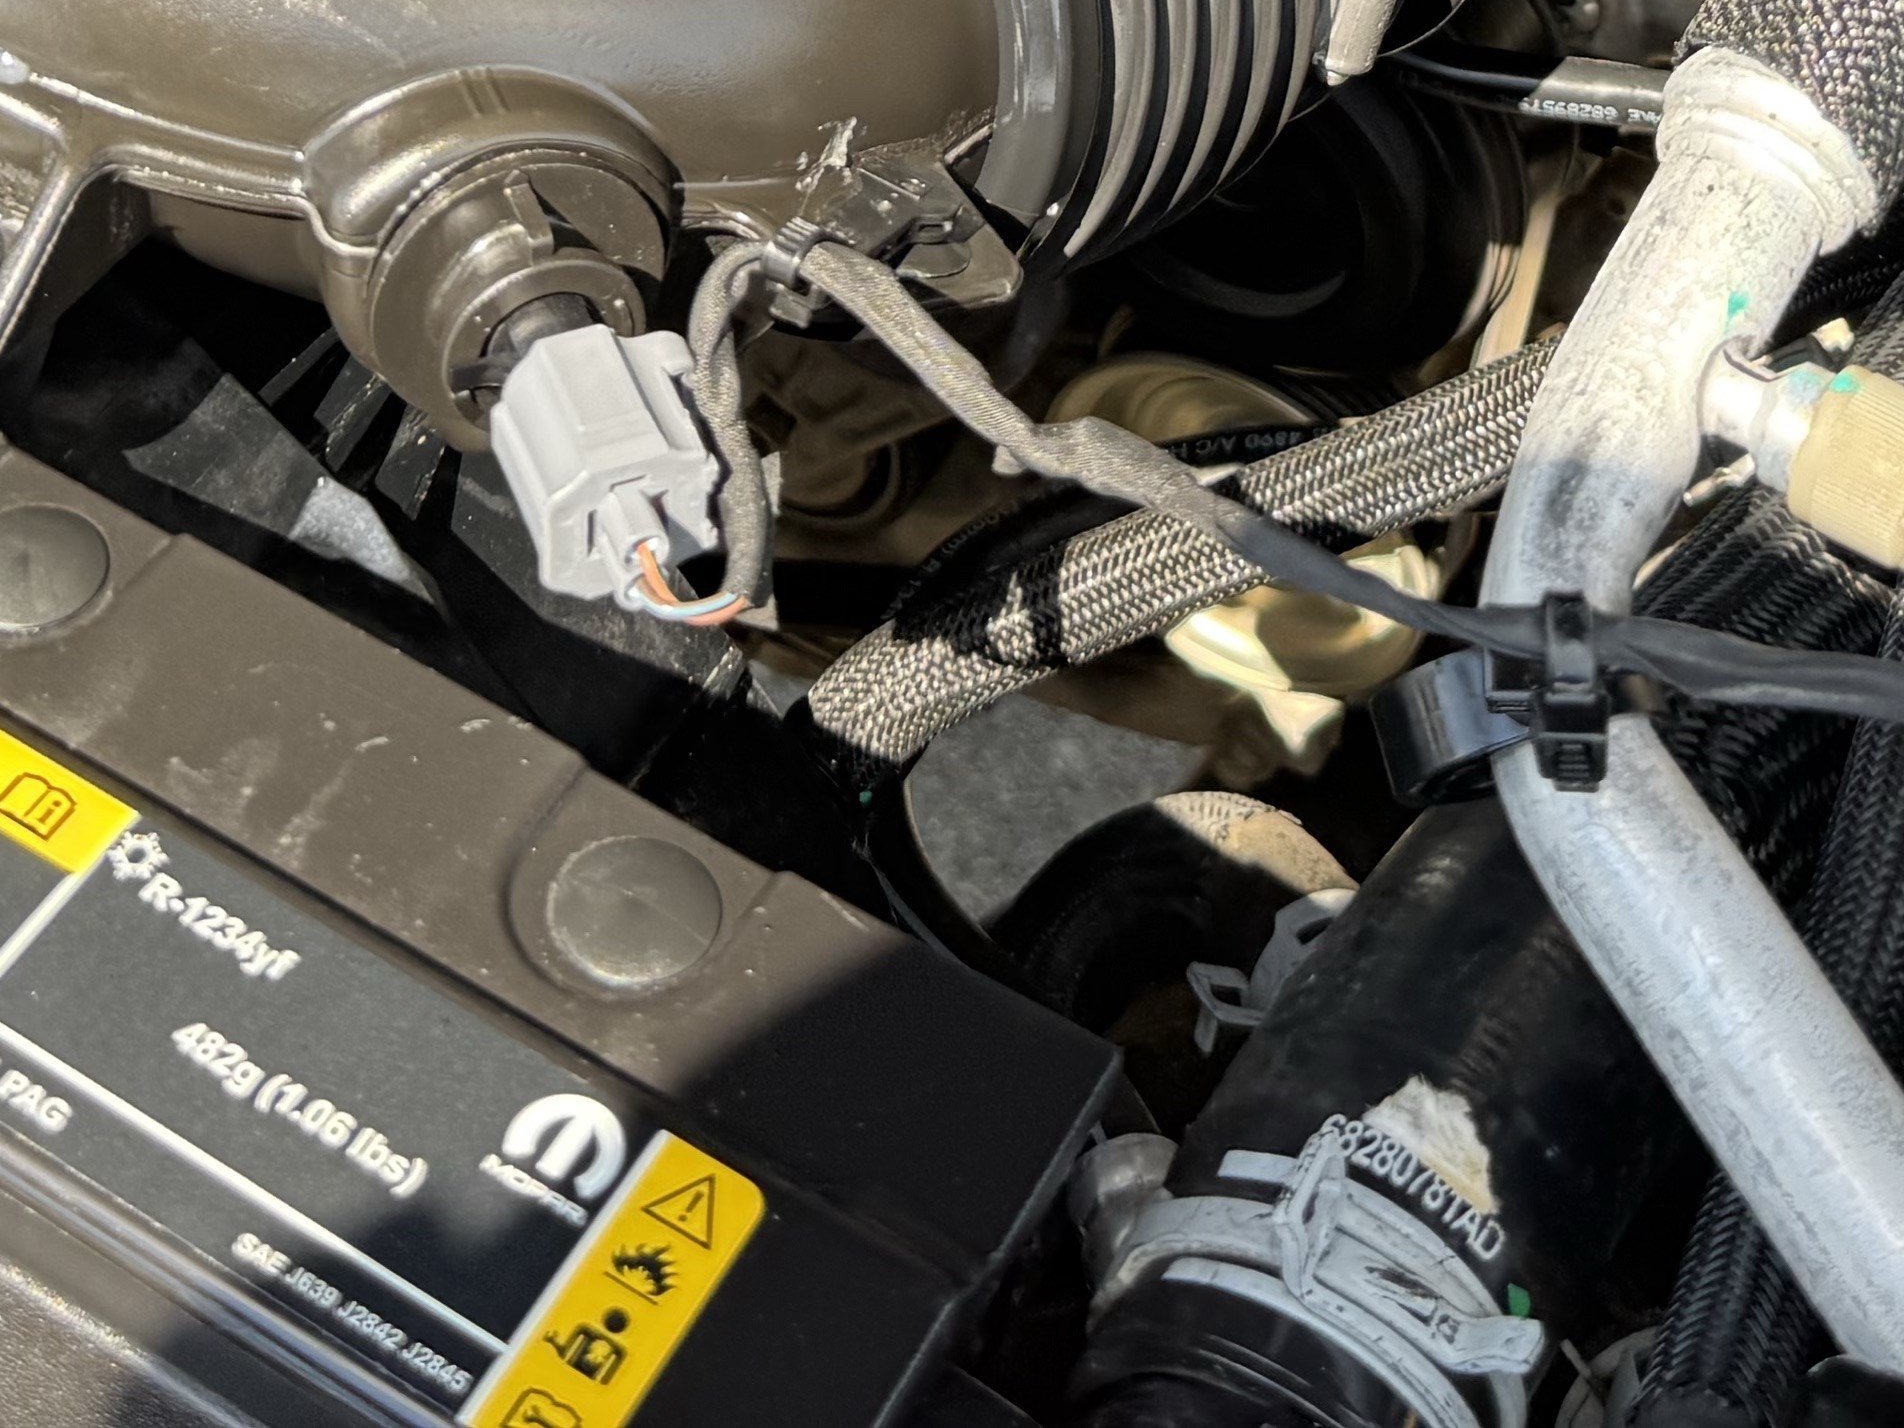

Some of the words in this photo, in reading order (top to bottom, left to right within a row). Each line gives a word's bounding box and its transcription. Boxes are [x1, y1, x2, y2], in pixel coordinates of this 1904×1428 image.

[138, 871, 301, 981] R-1234yf
[171, 1022, 266, 1100] 482g
[254, 1073, 358, 1151] (1.06
[344, 1126, 429, 1199] lbs)
[478, 1152, 590, 1229] MOPAR
[229, 1232, 293, 1278] SAE
[283, 1265, 342, 1309] J639
[337, 1299, 409, 1351] J2842
[400, 1341, 474, 1397] J2845
